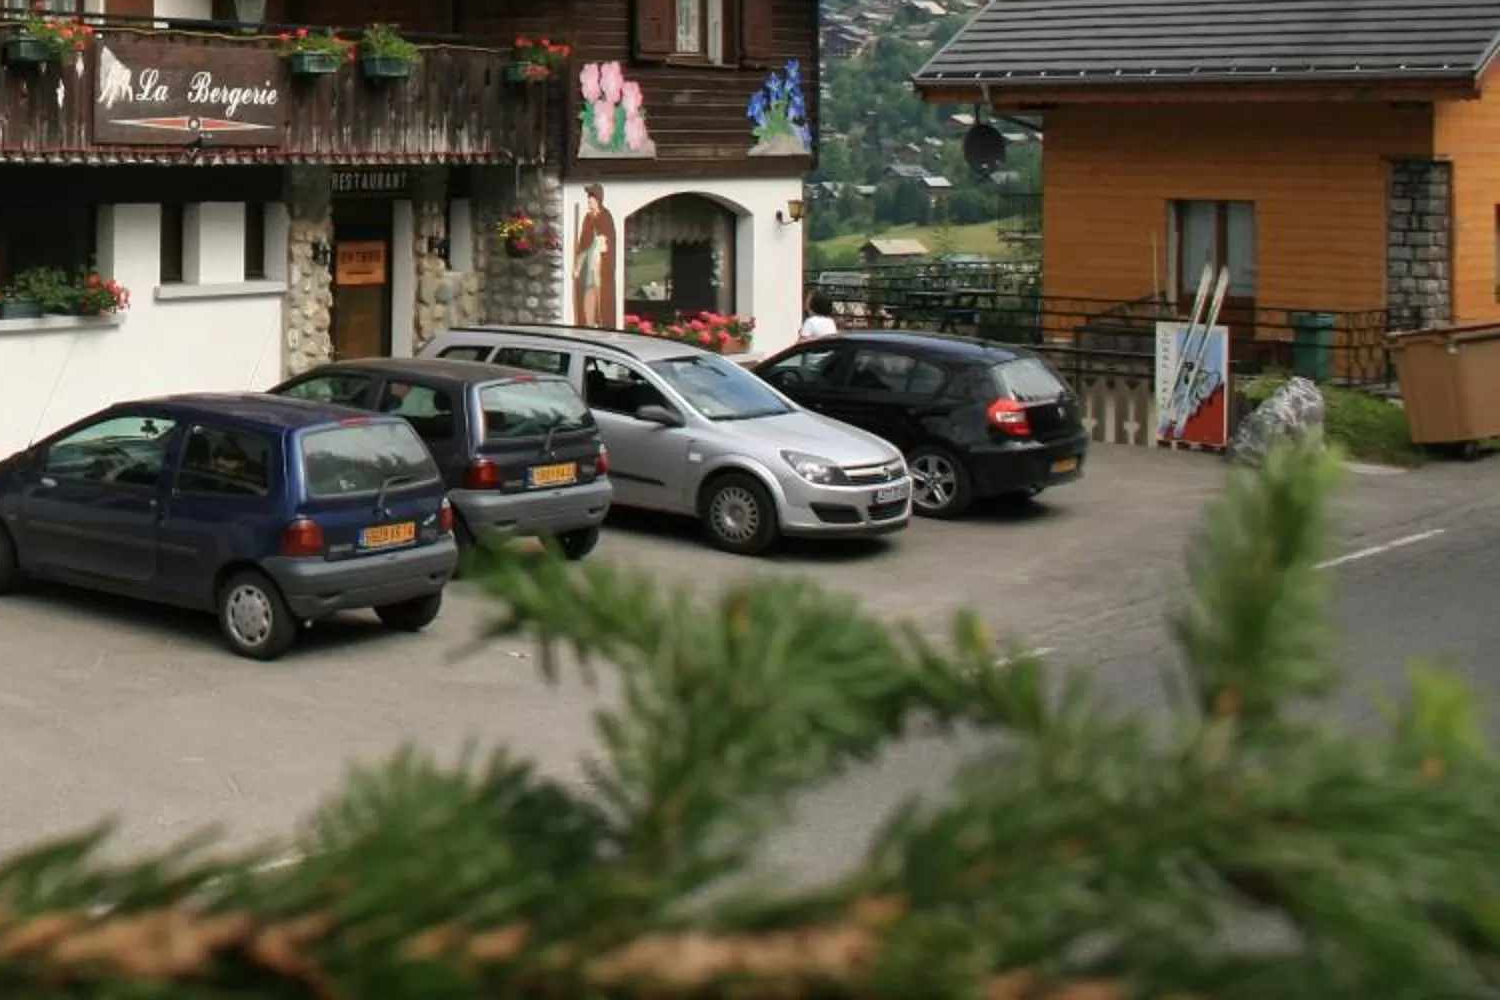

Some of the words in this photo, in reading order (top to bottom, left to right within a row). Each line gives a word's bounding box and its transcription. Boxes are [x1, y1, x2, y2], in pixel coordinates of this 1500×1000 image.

[136, 68, 169, 102] La
[187, 71, 279, 117] Bergerie
[331, 172, 407, 191] RESTAURANT
